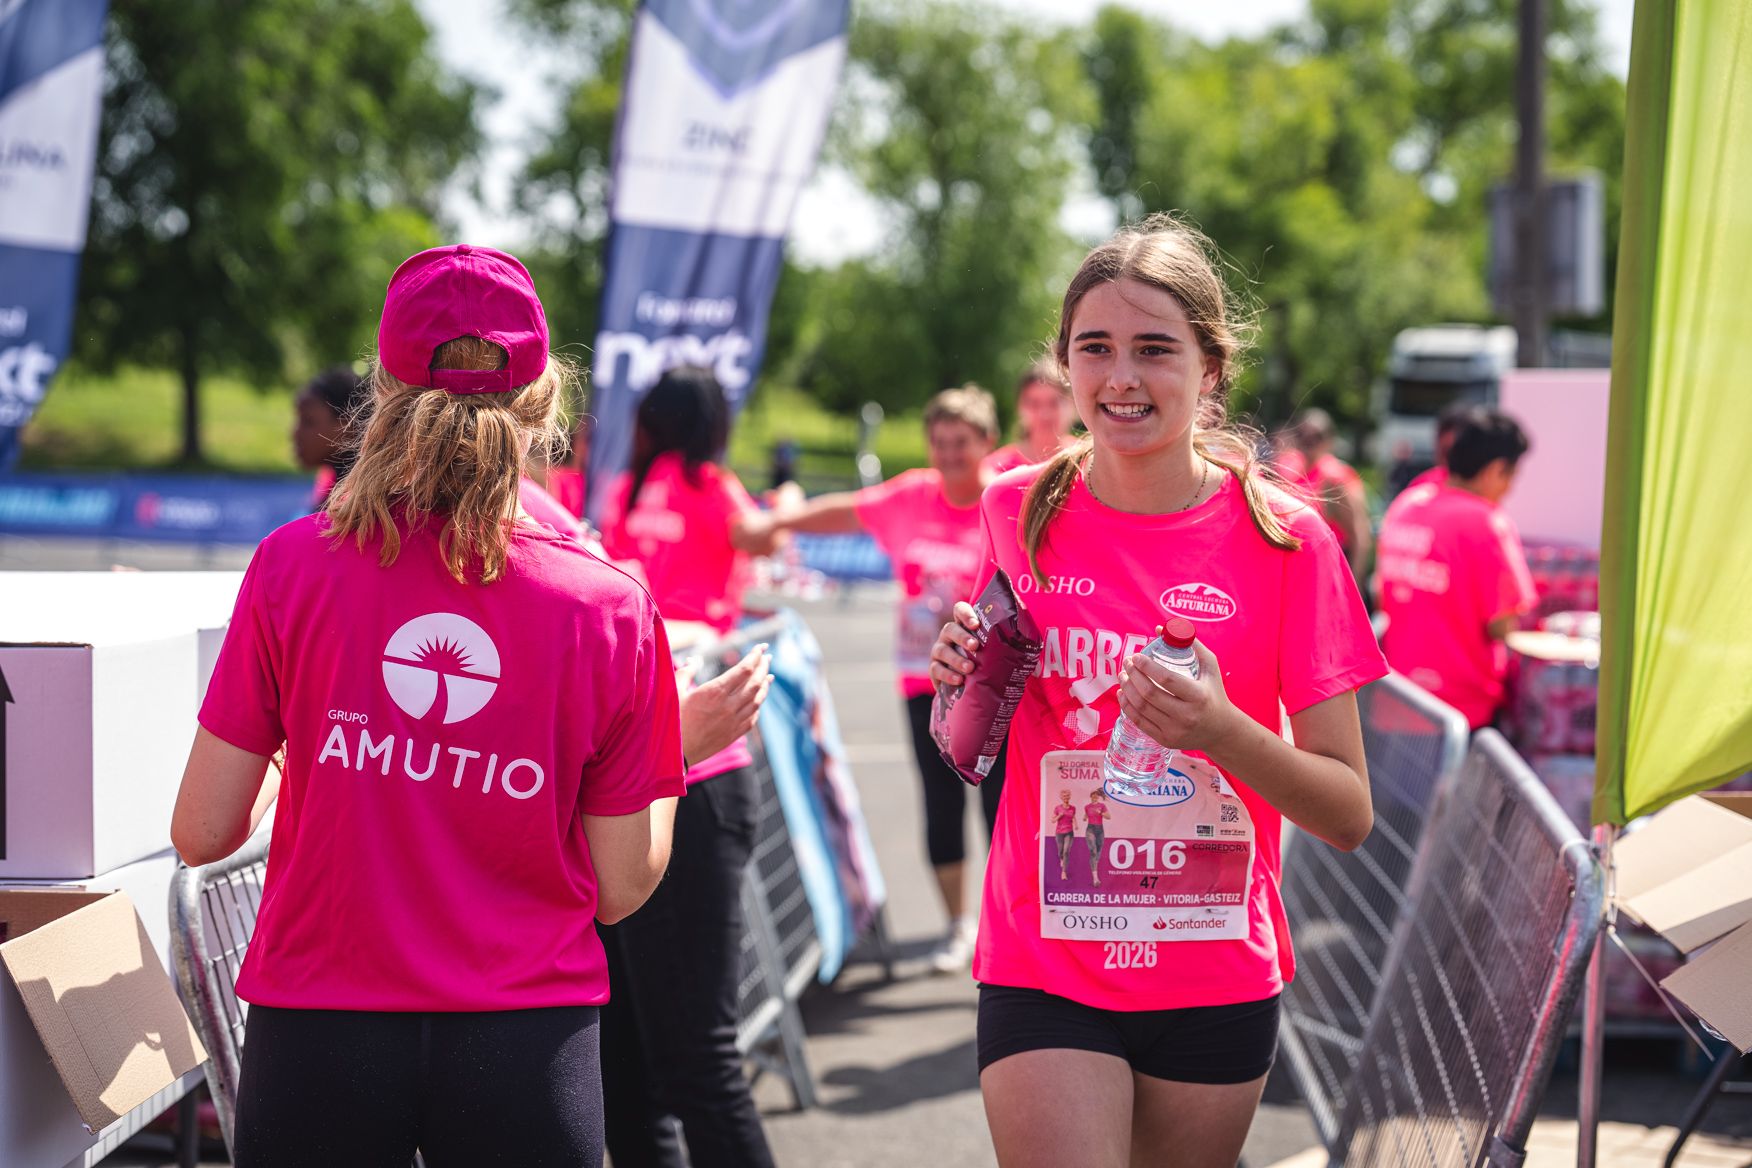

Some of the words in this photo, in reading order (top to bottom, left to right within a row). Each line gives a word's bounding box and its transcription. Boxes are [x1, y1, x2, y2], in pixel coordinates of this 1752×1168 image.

[1165, 592, 1230, 615] ASTURIANA
[328, 709, 368, 724] GRUPO
[318, 724, 545, 800] AMUTIO
[1070, 761, 1100, 769] DORSAL
[1060, 768, 1100, 780] SUMA
[1108, 839, 1187, 870] 016
[1192, 843, 1248, 853] CORREDORA
[1139, 876, 1159, 889] 47
[1047, 892, 1092, 903] CARRERA
[1093, 893, 1106, 903] DE
[1108, 893, 1121, 903] LA
[1123, 893, 1156, 904] MUJER
[1163, 893, 1241, 904] VITORIA-GASTEIZ
[1063, 914, 1128, 930] OYSHO
[1168, 918, 1226, 929] Santander
[1103, 941, 1158, 969] 2026
